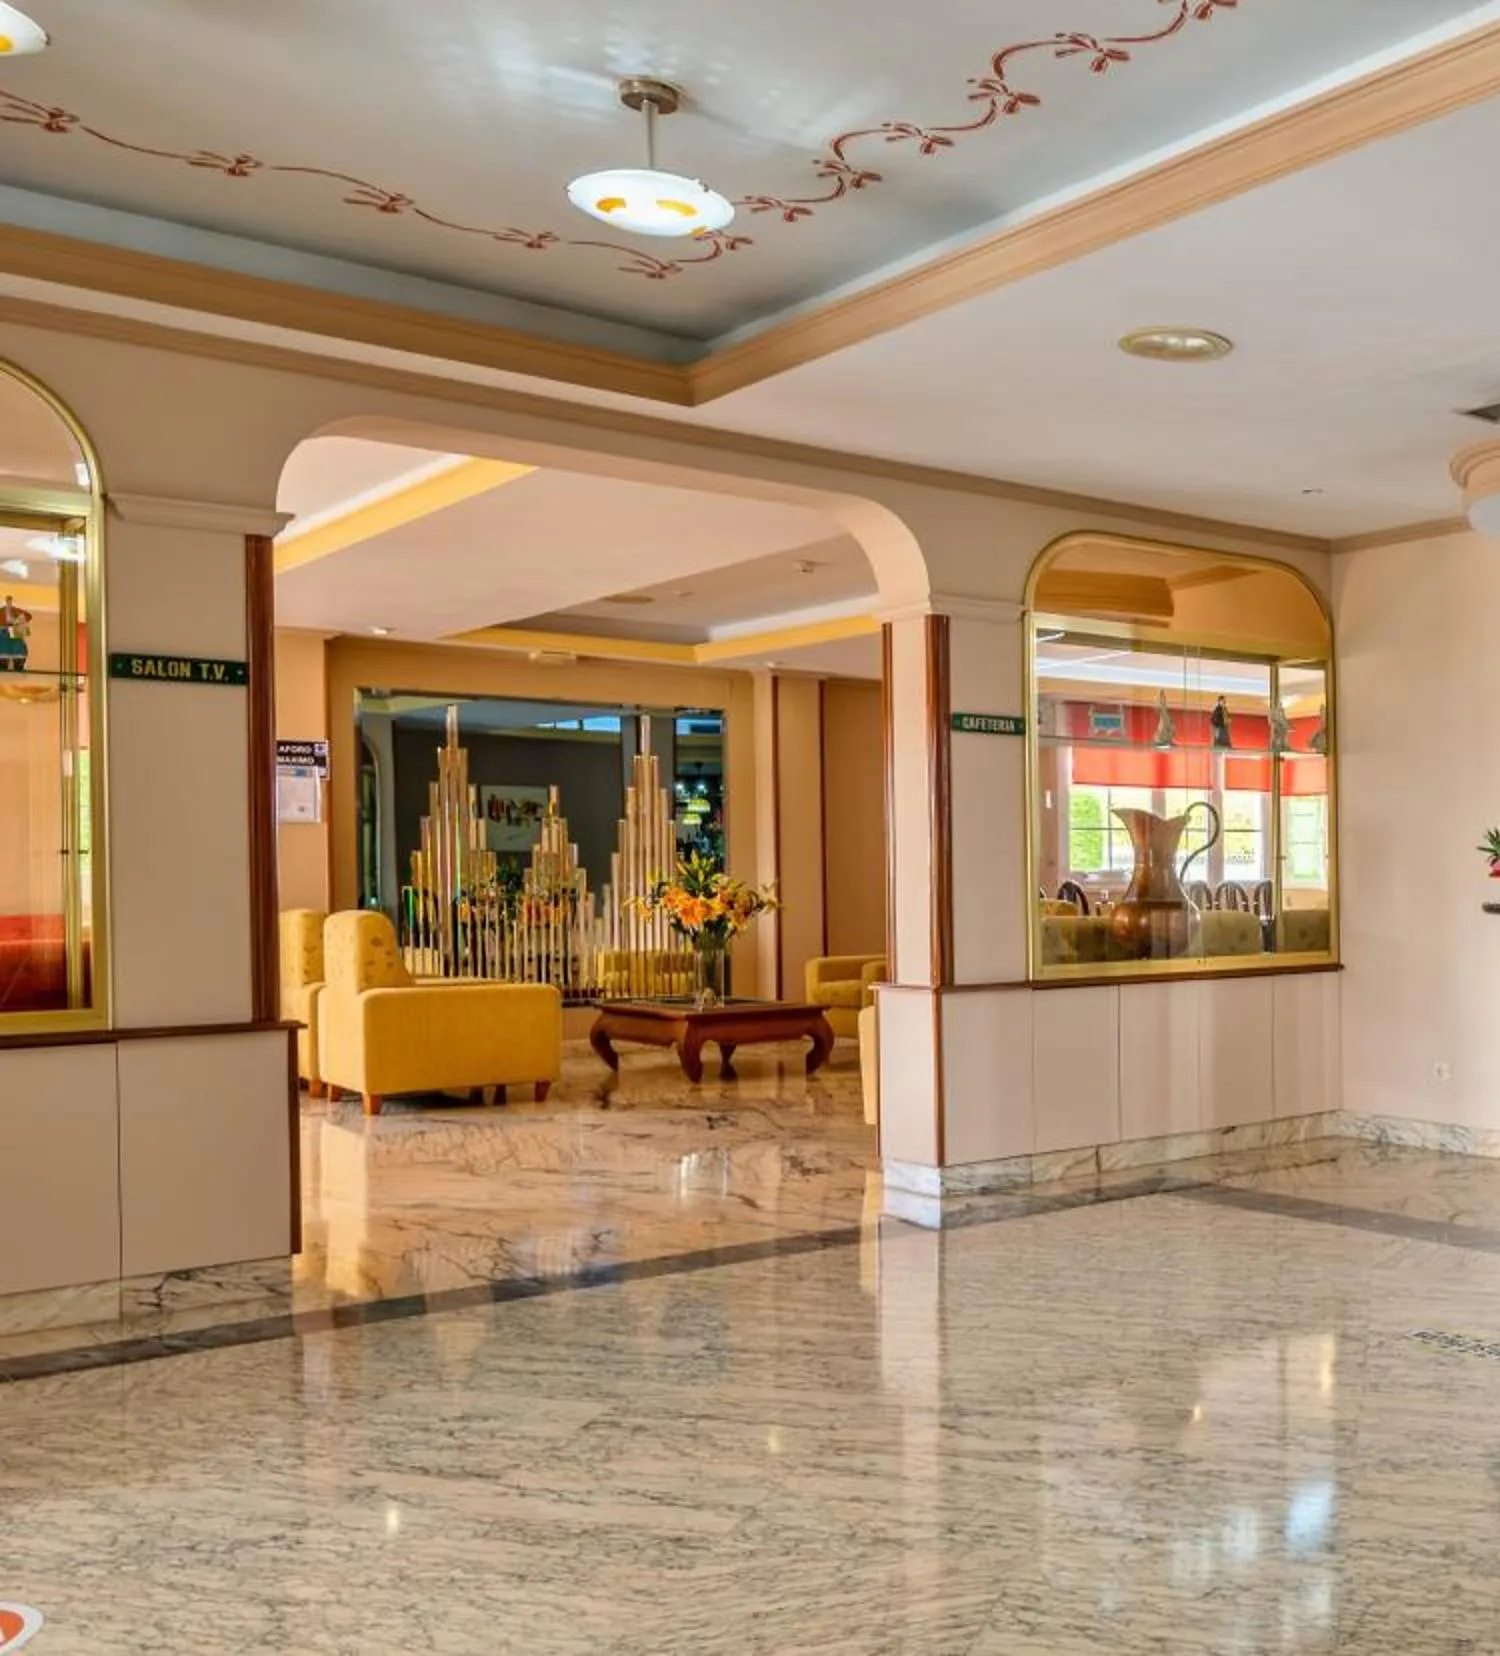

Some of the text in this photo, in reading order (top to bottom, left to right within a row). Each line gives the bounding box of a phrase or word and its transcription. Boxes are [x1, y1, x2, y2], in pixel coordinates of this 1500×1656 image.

[130, 658, 230, 681] SALON T.V.
[962, 716, 1016, 733] CAFETERIA
[279, 745, 313, 755] AFORO
